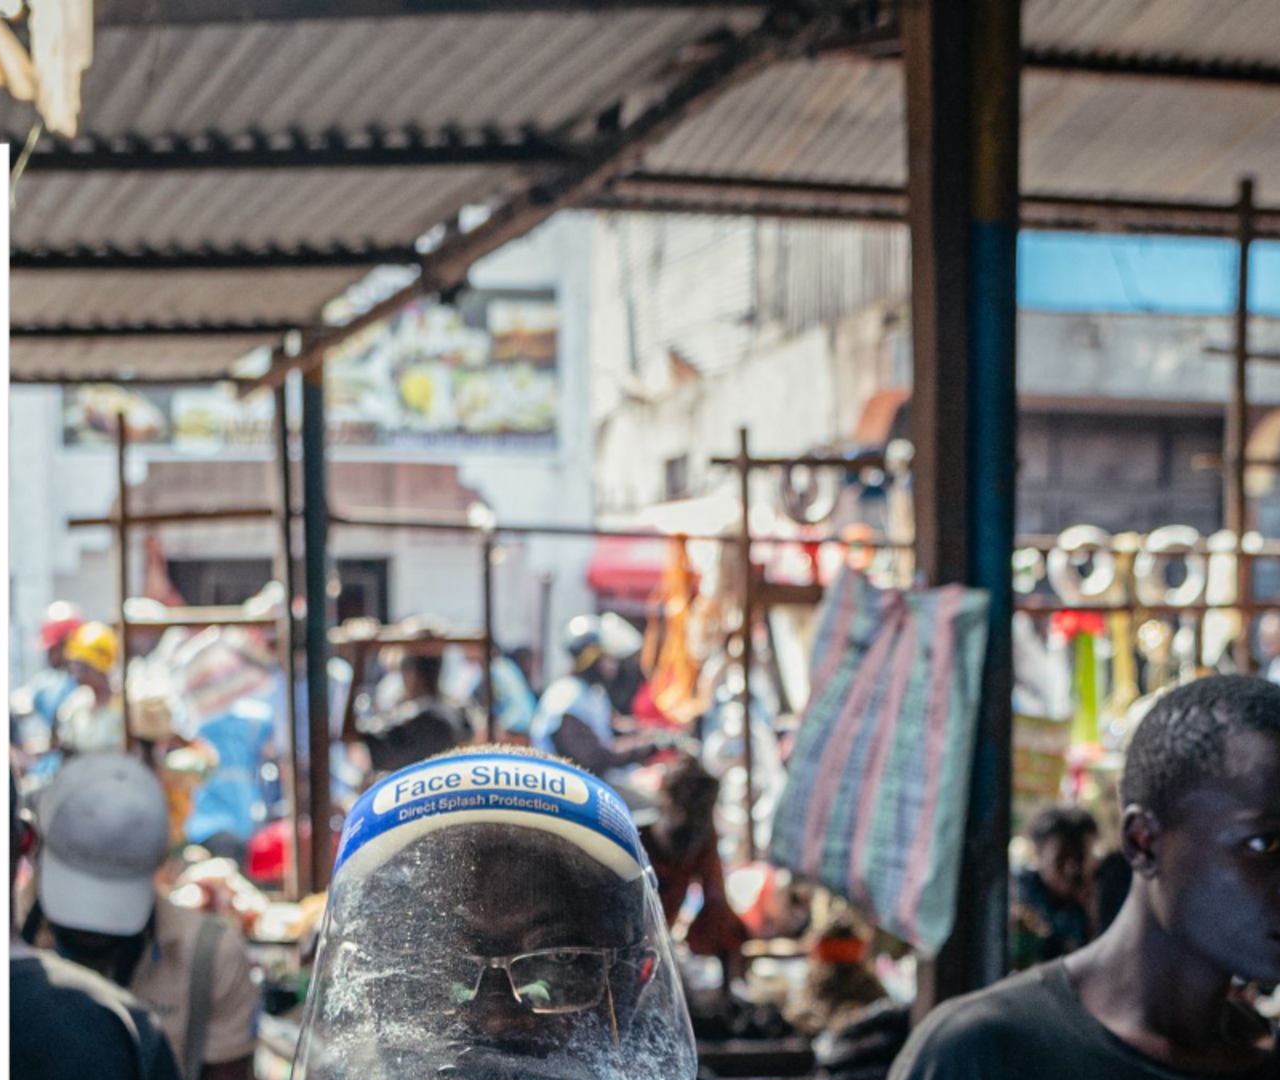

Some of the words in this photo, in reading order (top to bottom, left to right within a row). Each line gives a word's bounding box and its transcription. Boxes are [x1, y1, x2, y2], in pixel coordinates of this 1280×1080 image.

[395, 773, 461, 803] Face
[471, 766, 565, 795] Shield
[399, 800, 435, 820] Direct
[438, 794, 486, 811] Splash
[489, 794, 560, 813] Protection
